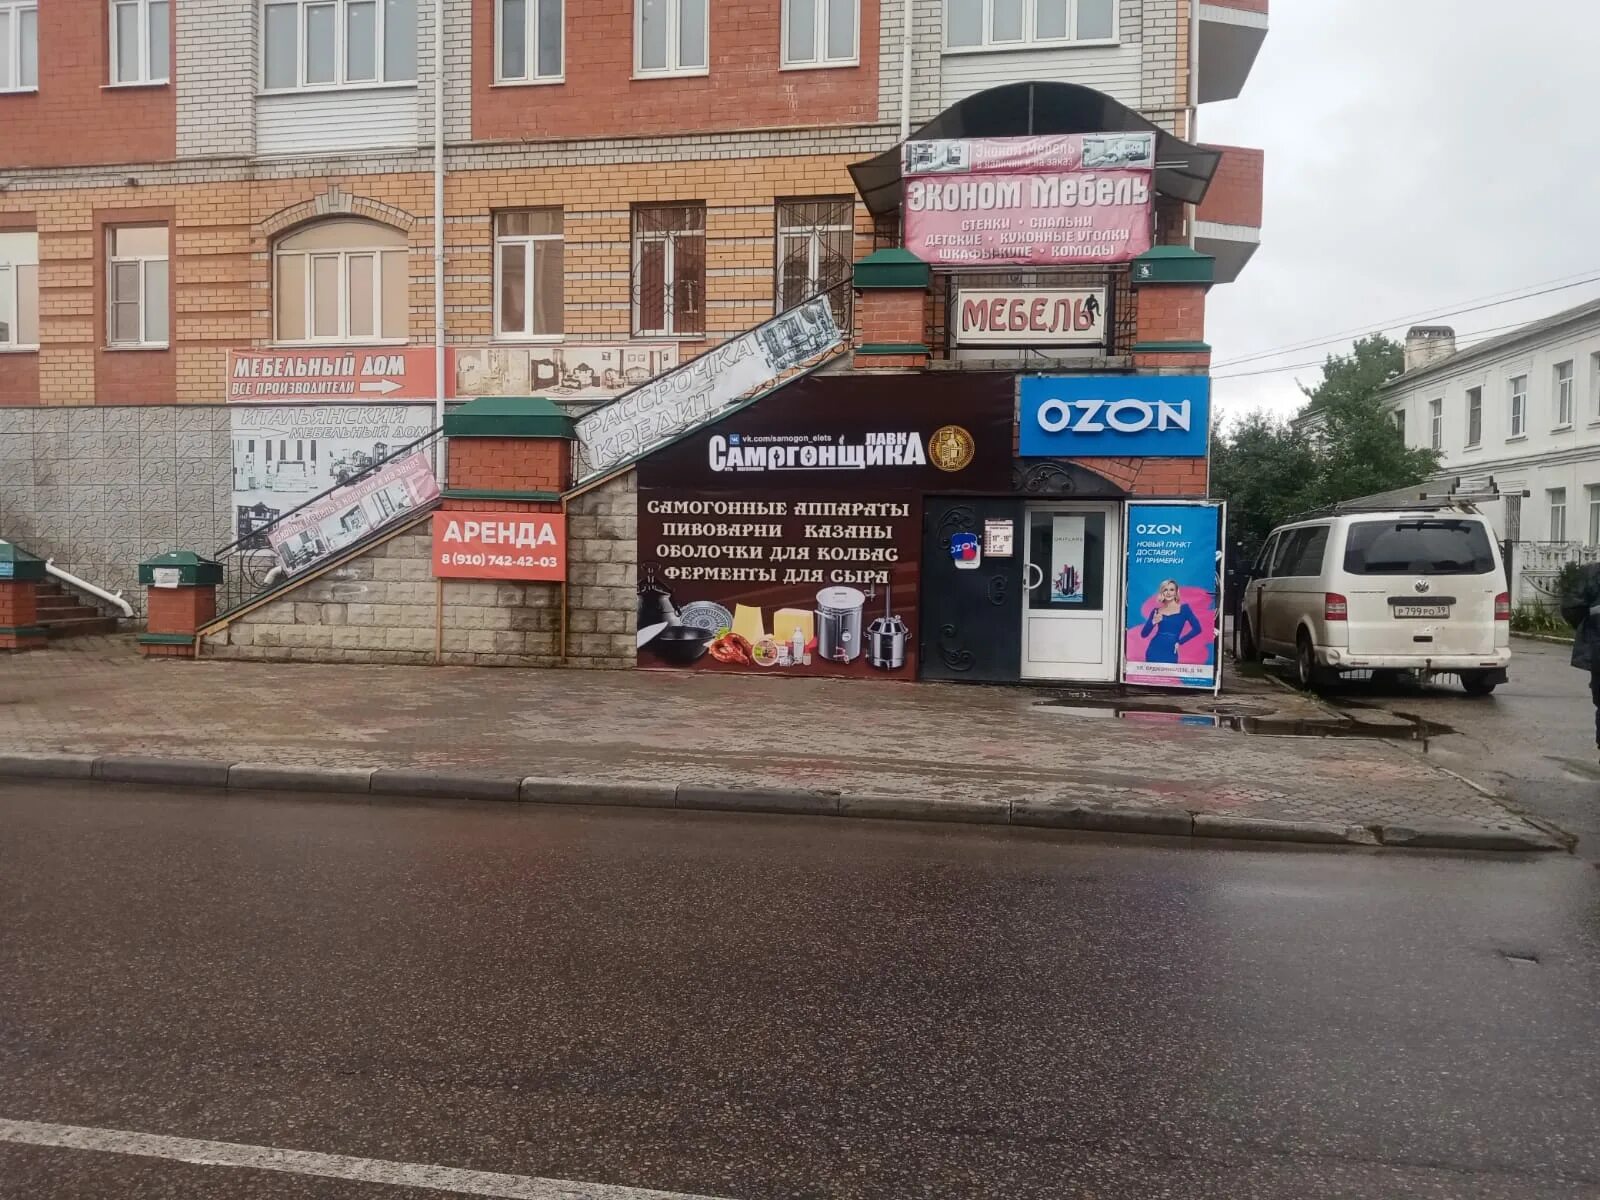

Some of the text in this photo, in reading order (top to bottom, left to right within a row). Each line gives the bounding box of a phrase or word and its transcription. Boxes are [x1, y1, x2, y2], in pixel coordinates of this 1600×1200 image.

[908, 173, 1150, 212] Эконом Мебель
[961, 216, 1093, 231] СТЕНКИ СПАЛЬНИ
[925, 229, 1129, 246] ДЕТСКИЕ КУХОННЫЕ УГОЛКИ
[939, 245, 1114, 260] ШКАФЫ-КУПЕ КОМОДЫ
[962, 297, 1094, 332] МЕБЕЛЬ
[233, 352, 406, 378] МЕБЕЛЬНЫЙ ДОМ
[232, 381, 355, 395] ВСЕ ПРОИЗВОДИТЕЛИ
[583, 338, 755, 442] РАССРОЧКА
[241, 406, 409, 425] ИТАЛЬЯНСКИЙ
[1037, 398, 1191, 432] OZON
[289, 424, 430, 439] МЕБЕЛЬНЫЙ ДОМ
[594, 385, 715, 466] КРЕДИТ
[742, 434, 832, 444] vk.com/samogon_elets
[647, 500, 910, 517] САМОГОННЫЕ АППАРАТЫ
[442, 520, 557, 549] АРЕНДА
[662, 523, 893, 539] ПИВОВАРНИ КАЗАНЫ
[1136, 524, 1182, 535] OZON
[1136, 540, 1164, 548] НОВЫЙ
[441, 552, 557, 567] 8 (910) 742-42-03
[656, 544, 898, 562] ОБОЛОЧКИ ДЛЯ КОЛБАС
[664, 566, 889, 584] ФЕРМЕНТЫ ДЛЯ СЫРА
